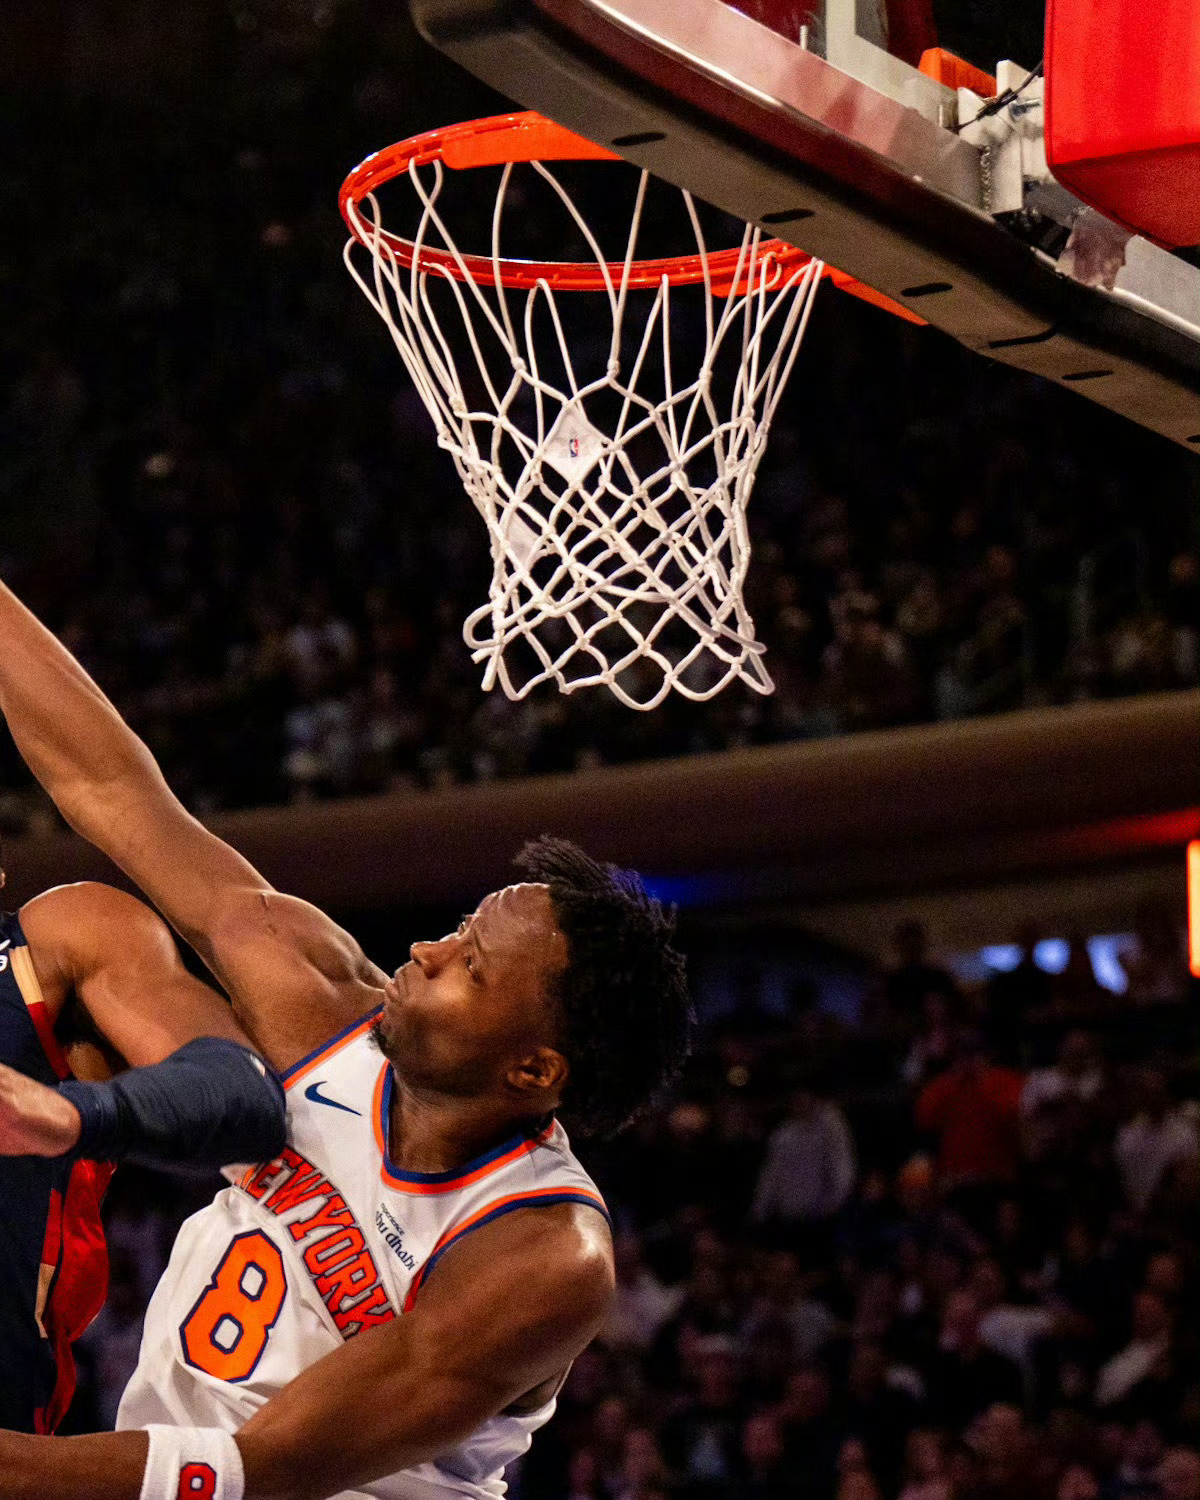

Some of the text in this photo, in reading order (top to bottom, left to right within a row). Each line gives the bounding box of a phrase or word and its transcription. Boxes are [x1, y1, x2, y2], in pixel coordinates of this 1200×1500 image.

[179, 1228, 288, 1383] 8
[236, 1146, 396, 1342] EW YORK
